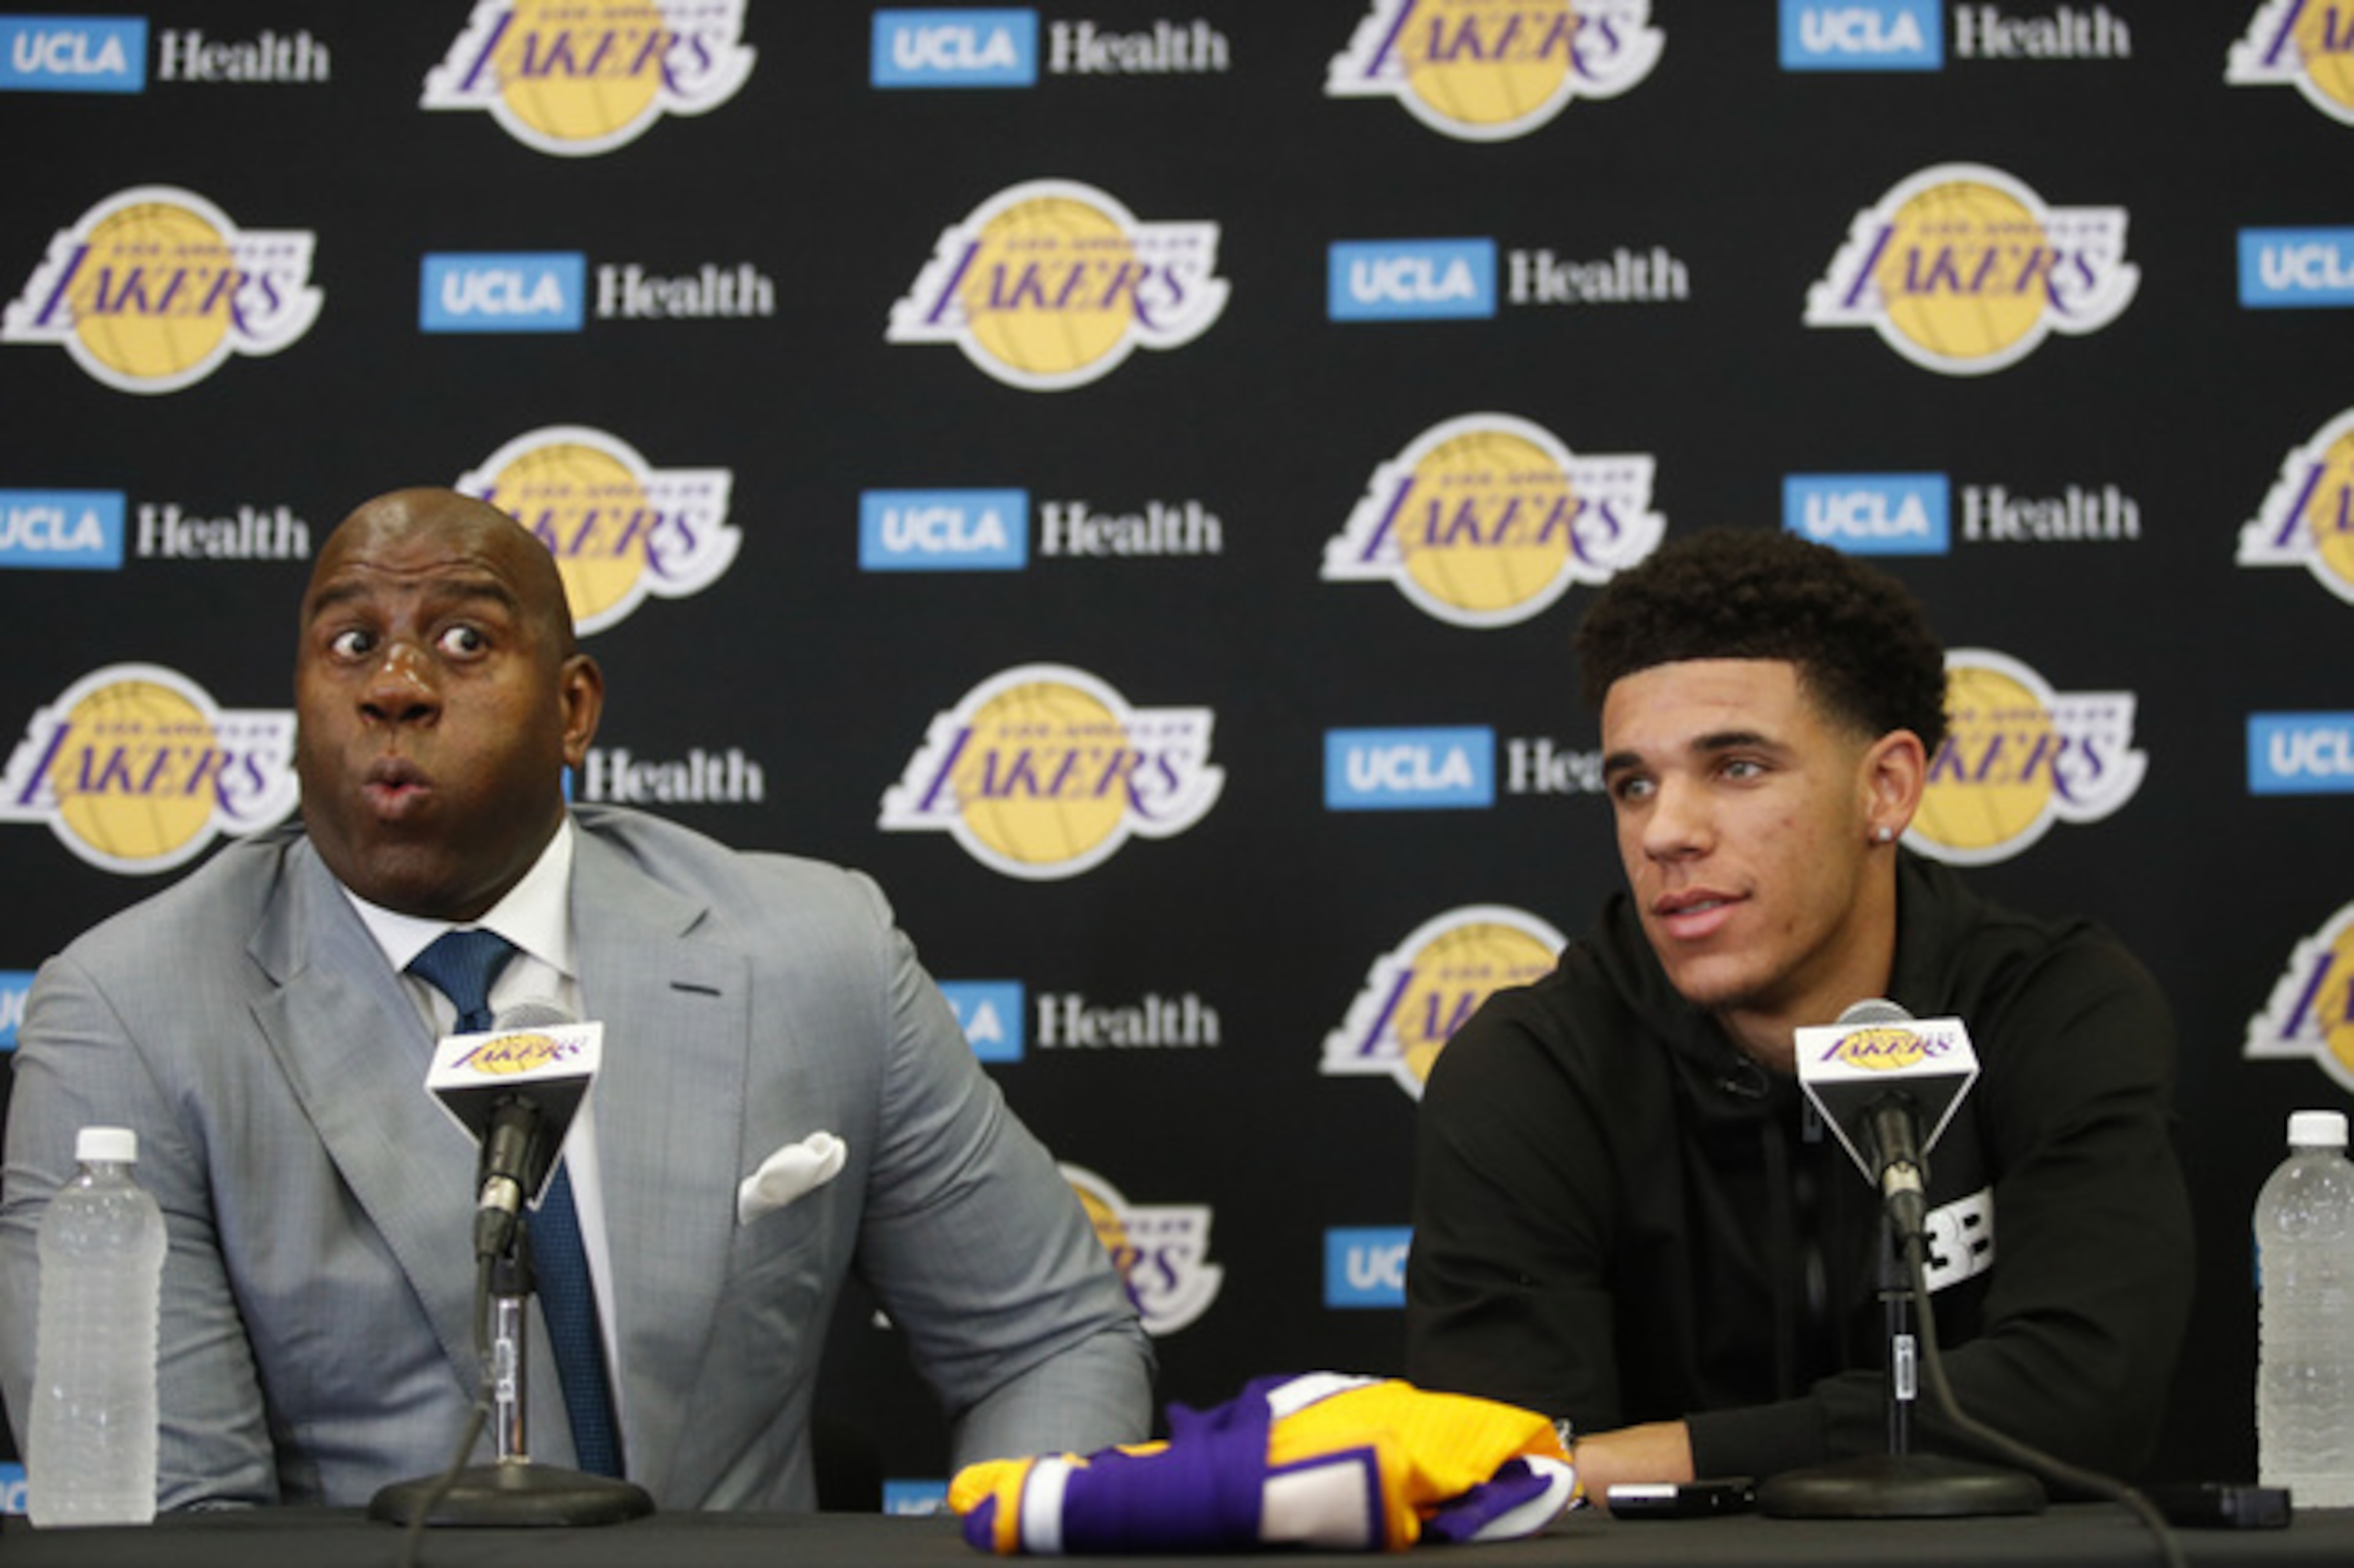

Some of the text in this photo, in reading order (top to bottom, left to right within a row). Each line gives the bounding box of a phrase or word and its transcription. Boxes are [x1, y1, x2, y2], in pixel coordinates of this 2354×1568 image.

[12, 29, 330, 81] UCLA Health
[456, 10, 718, 98] LAKERS
[892, 20, 1228, 74] UCLA Health
[1363, 0, 1628, 82] LAKERS
[1800, 5, 2131, 58] UCLA Health
[34, 244, 292, 341] LAKERS
[441, 263, 775, 318] UCLA Health
[923, 238, 1192, 334] LAKERS
[1349, 247, 1689, 304] UCLA Health
[1842, 223, 2105, 319] LAKERS
[2259, 243, 2354, 290] UCL
[136, 503, 310, 559] Health
[880, 500, 1223, 557] UCLA Health
[1358, 476, 1632, 567] LAKERS
[1804, 485, 2139, 541] UCLA Health
[16, 721, 277, 820] LAKERS
[585, 747, 764, 802] Health
[913, 726, 1190, 822] LAKERS
[1346, 744, 1474, 791] UCLA
[1929, 732, 2113, 804] KERS
[2269, 729, 2354, 775] UCL
[1037, 994, 1219, 1048] Health
[1821, 1037, 1952, 1062] LAKERS
[1348, 1246, 1409, 1288] UC
